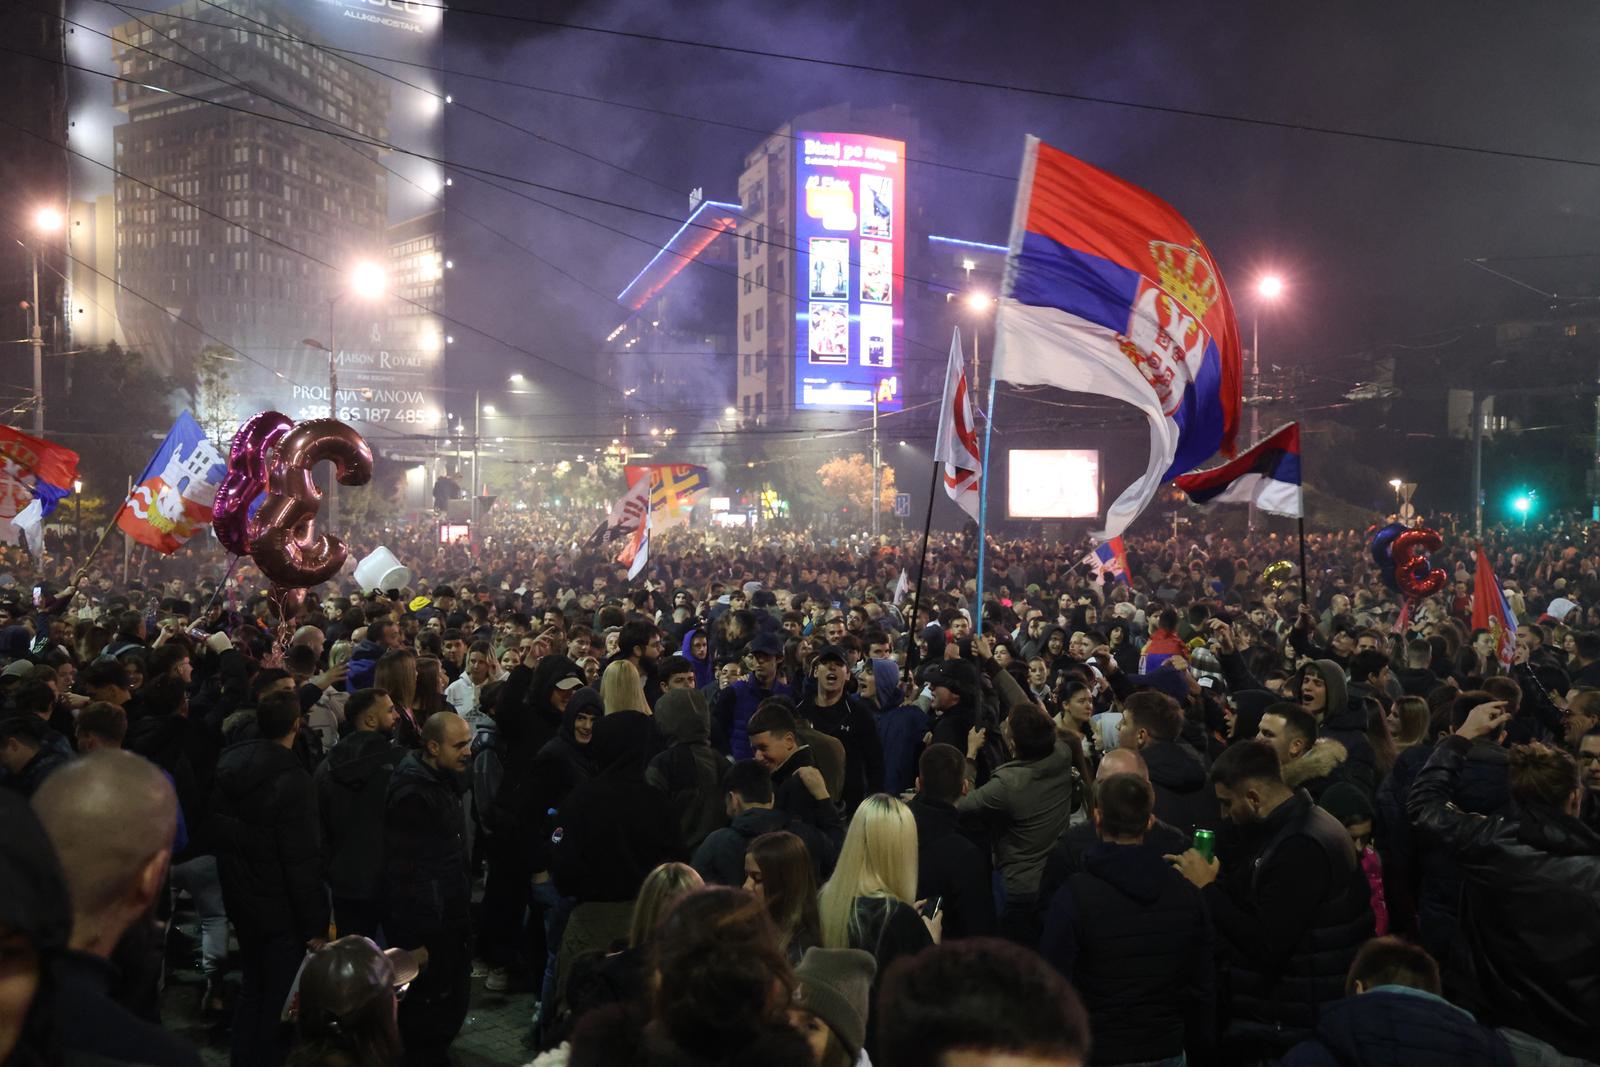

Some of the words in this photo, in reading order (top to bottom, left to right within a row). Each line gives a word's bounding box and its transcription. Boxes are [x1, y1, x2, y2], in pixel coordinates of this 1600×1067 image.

[298, 404, 333, 420] +38
[363, 407, 391, 422] 187
[394, 409, 425, 424] 485
